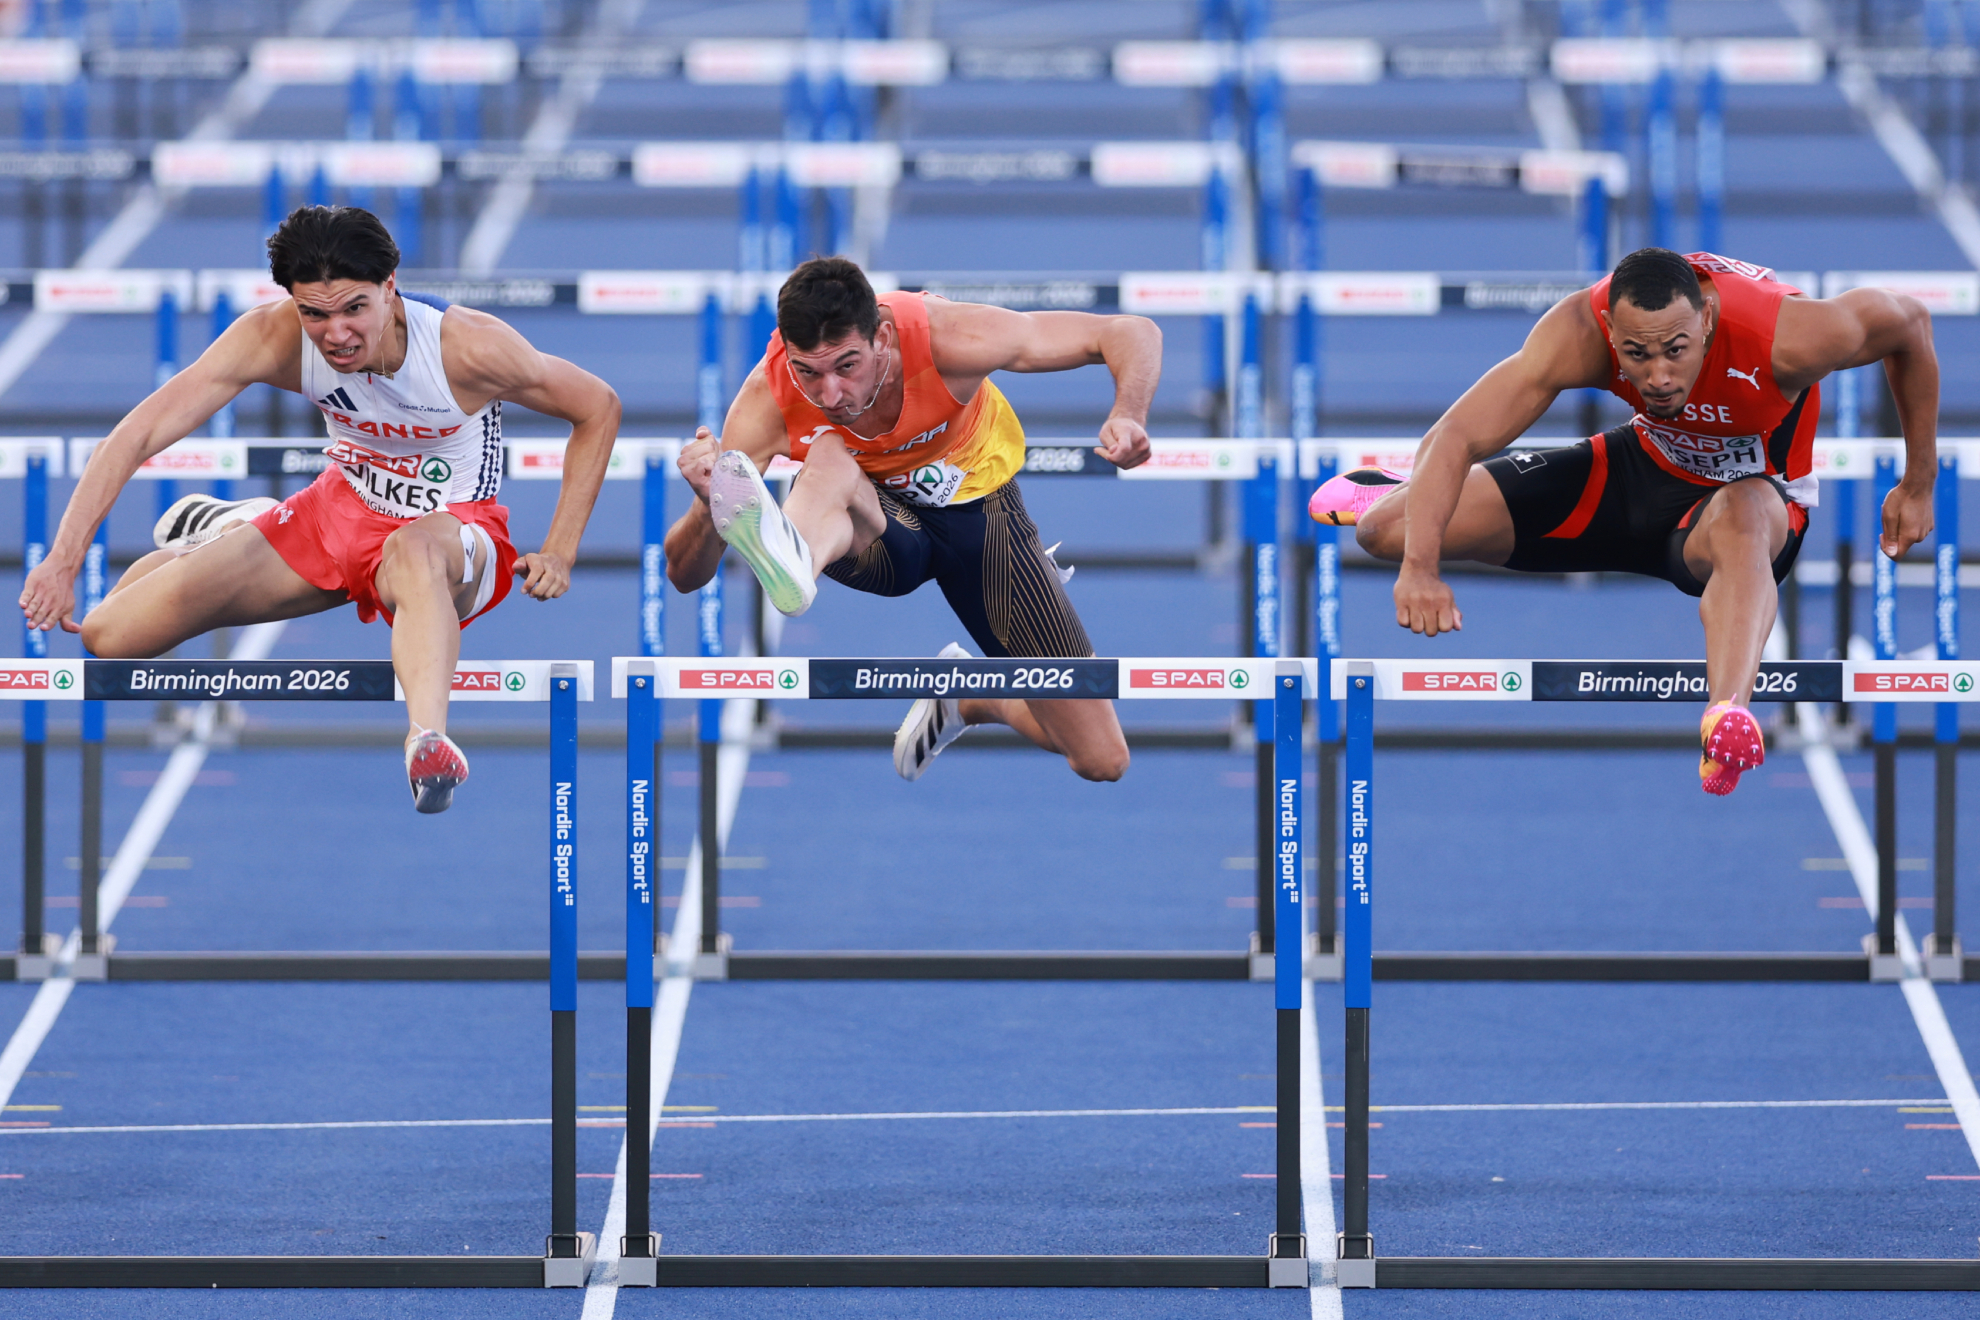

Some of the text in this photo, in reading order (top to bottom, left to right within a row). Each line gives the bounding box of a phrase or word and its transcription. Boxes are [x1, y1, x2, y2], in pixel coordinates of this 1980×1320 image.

[1650, 432, 1758, 469] OSEPH
[937, 473, 959, 504] 2026
[0, 673, 48, 686] PAR
[130, 668, 350, 697] Birmingham 2026
[452, 674, 499, 688] PAR
[701, 672, 773, 686] SPAR
[855, 667, 1074, 695] Birmingham 2026
[1151, 671, 1223, 686] SPAR
[1424, 674, 1496, 688] SPAR
[1577, 670, 1798, 699] Birmingha 026
[1875, 675, 1948, 689] SPAR
[553, 782, 573, 893] Nordic Sport
[630, 779, 649, 890] Nordic Sport
[1278, 779, 1298, 890] Nordic Sport
[1348, 780, 1368, 891] Nordic Sport
